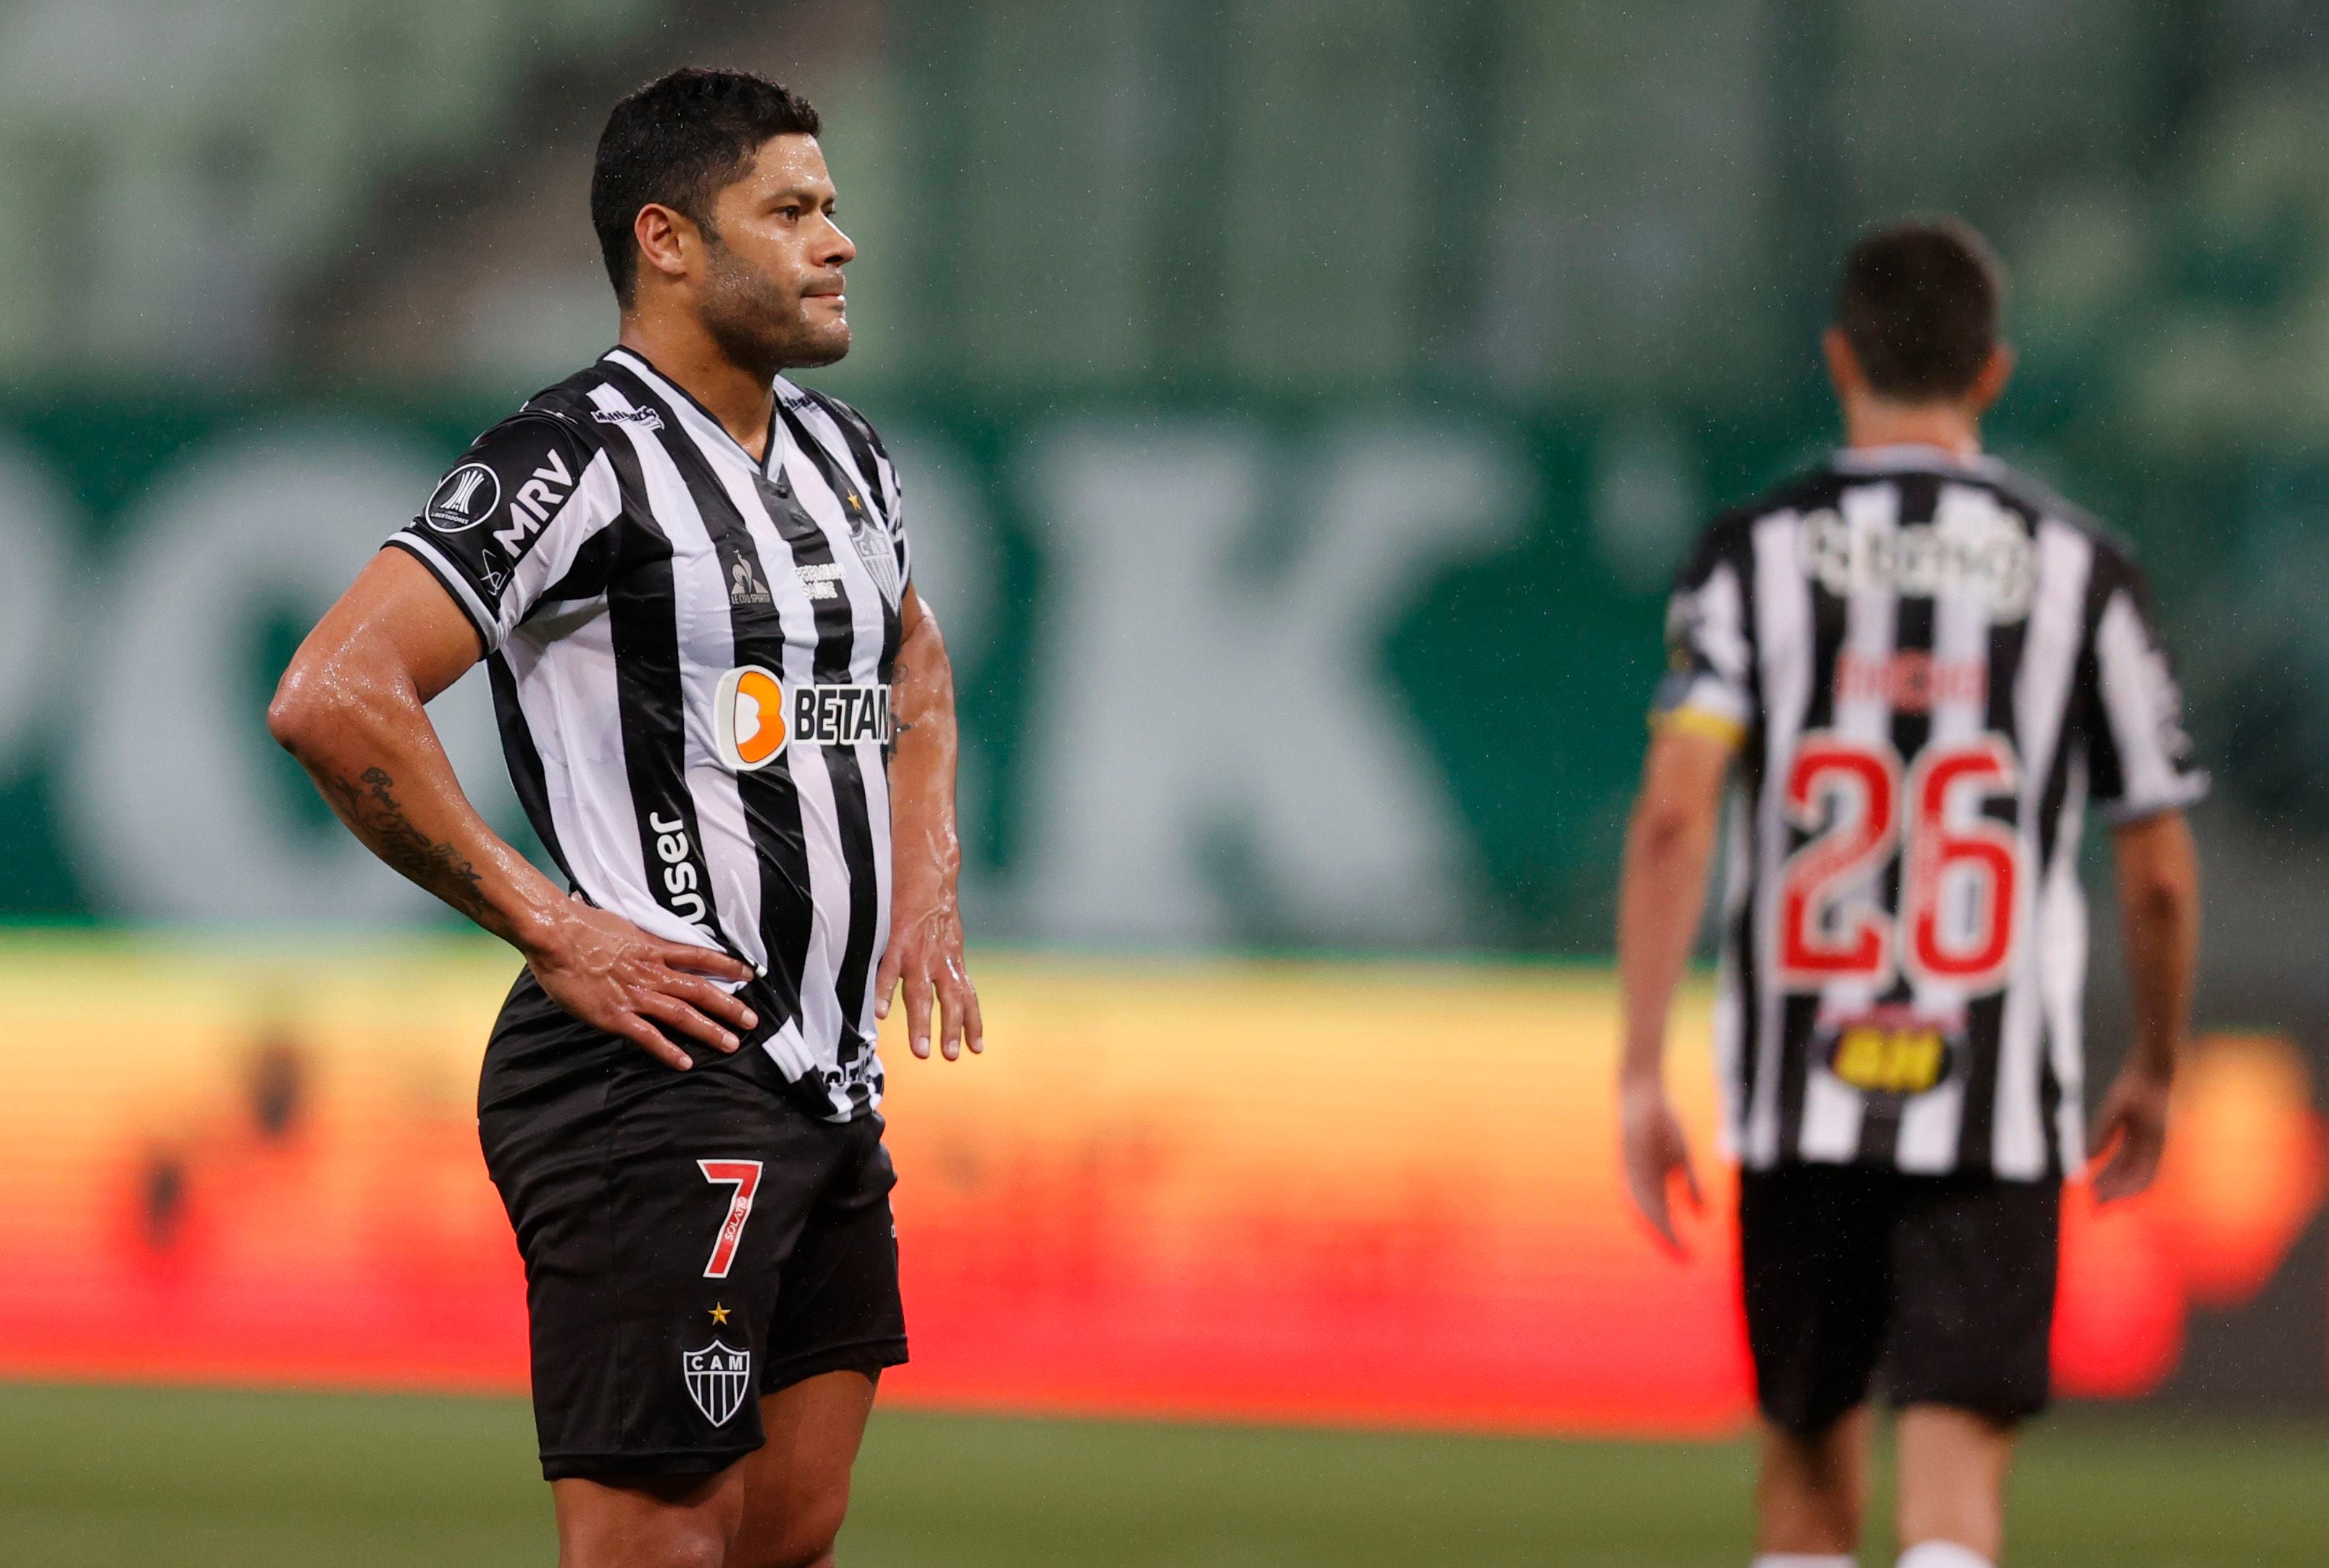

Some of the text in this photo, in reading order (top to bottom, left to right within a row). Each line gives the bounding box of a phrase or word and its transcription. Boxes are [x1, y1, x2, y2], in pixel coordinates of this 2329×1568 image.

[430, 511, 469, 524] LIBERTADORES
[493, 448, 572, 558] MRV
[649, 811, 717, 938] user
[1775, 731, 2023, 998] 26
[696, 1159, 764, 1279] 7
[690, 1355, 744, 1372] CAM
